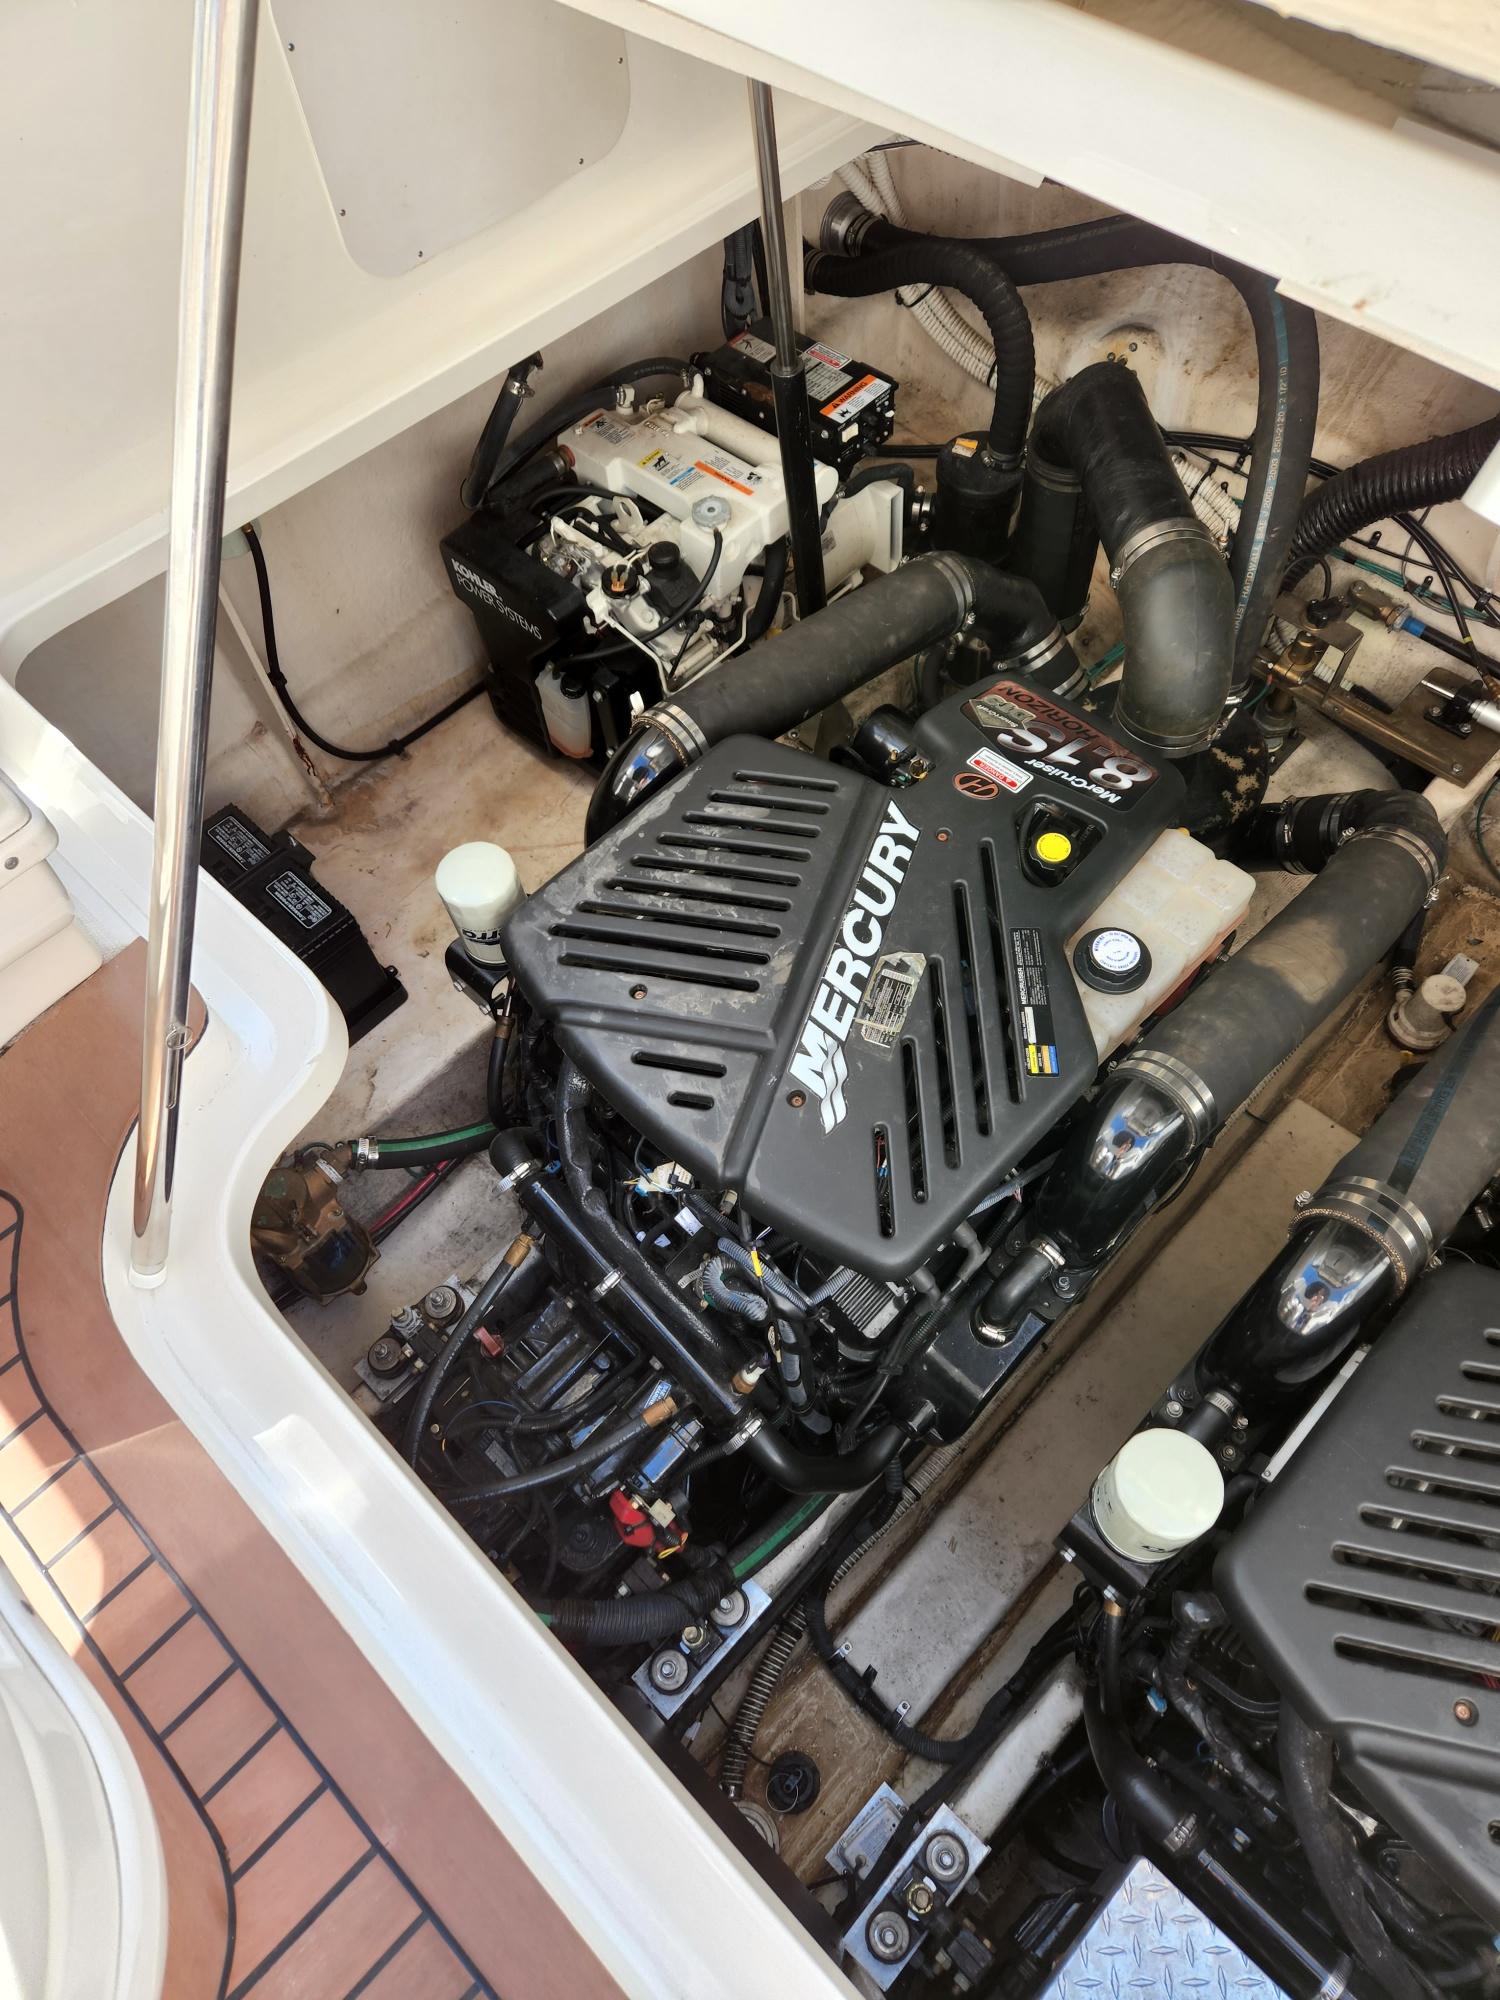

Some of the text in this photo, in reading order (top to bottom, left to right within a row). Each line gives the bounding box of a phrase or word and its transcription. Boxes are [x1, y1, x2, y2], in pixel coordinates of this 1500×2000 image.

[456, 572, 542, 641] POWER SYSTEMS
[999, 684, 1098, 742] HORIZON
[1024, 758, 1122, 804] MerCruiser
[789, 800, 921, 1101] MERCURY
